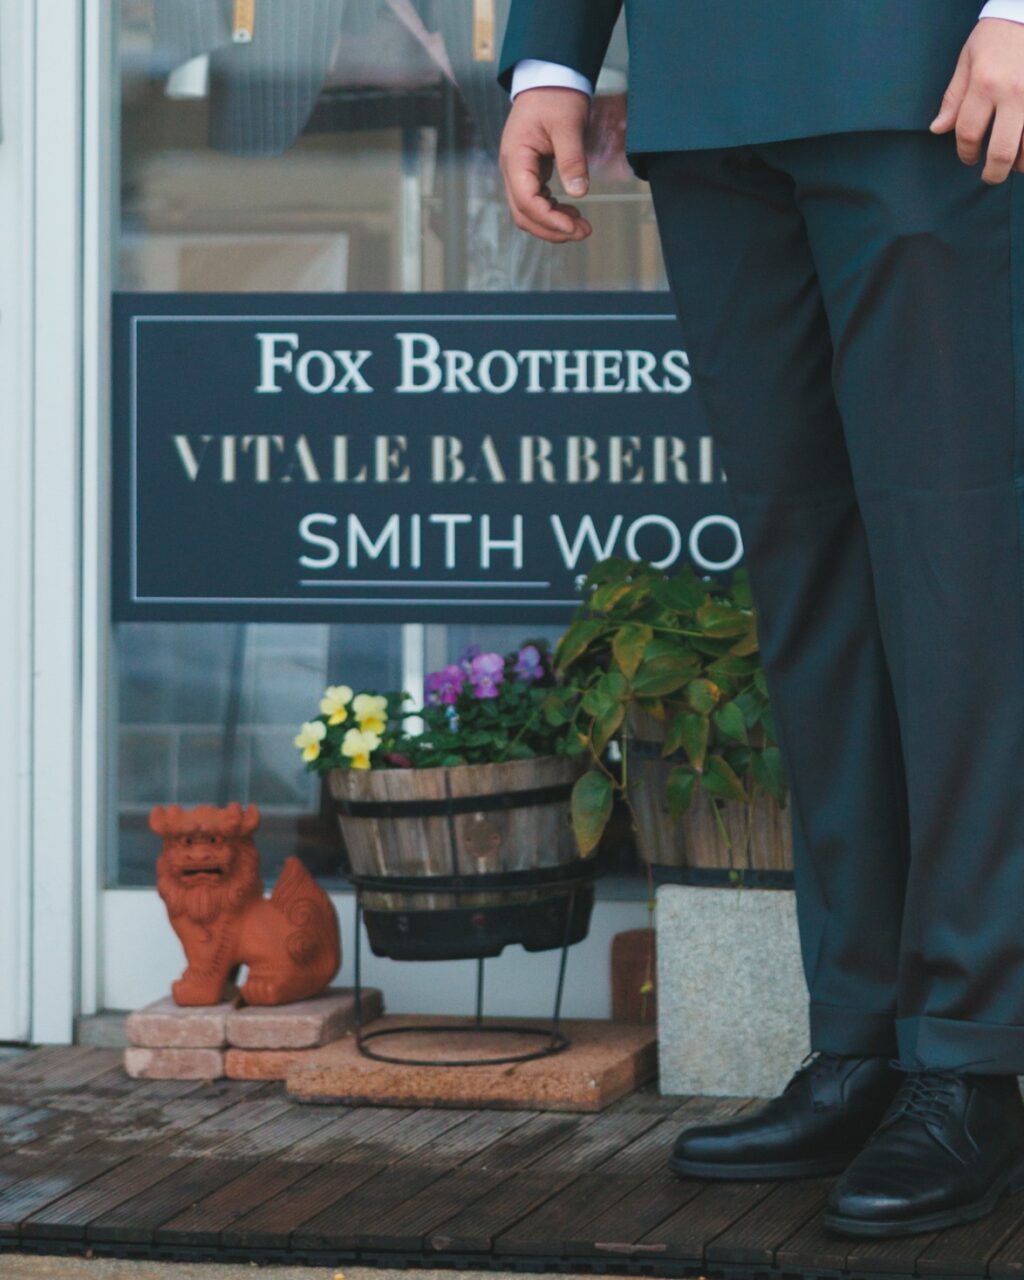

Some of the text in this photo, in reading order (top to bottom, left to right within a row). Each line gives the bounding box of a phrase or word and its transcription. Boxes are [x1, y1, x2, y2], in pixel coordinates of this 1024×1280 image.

[172, 434, 411, 483] VITALE
[431, 434, 728, 484] BARBERI
[298, 513, 523, 570] SMITH
